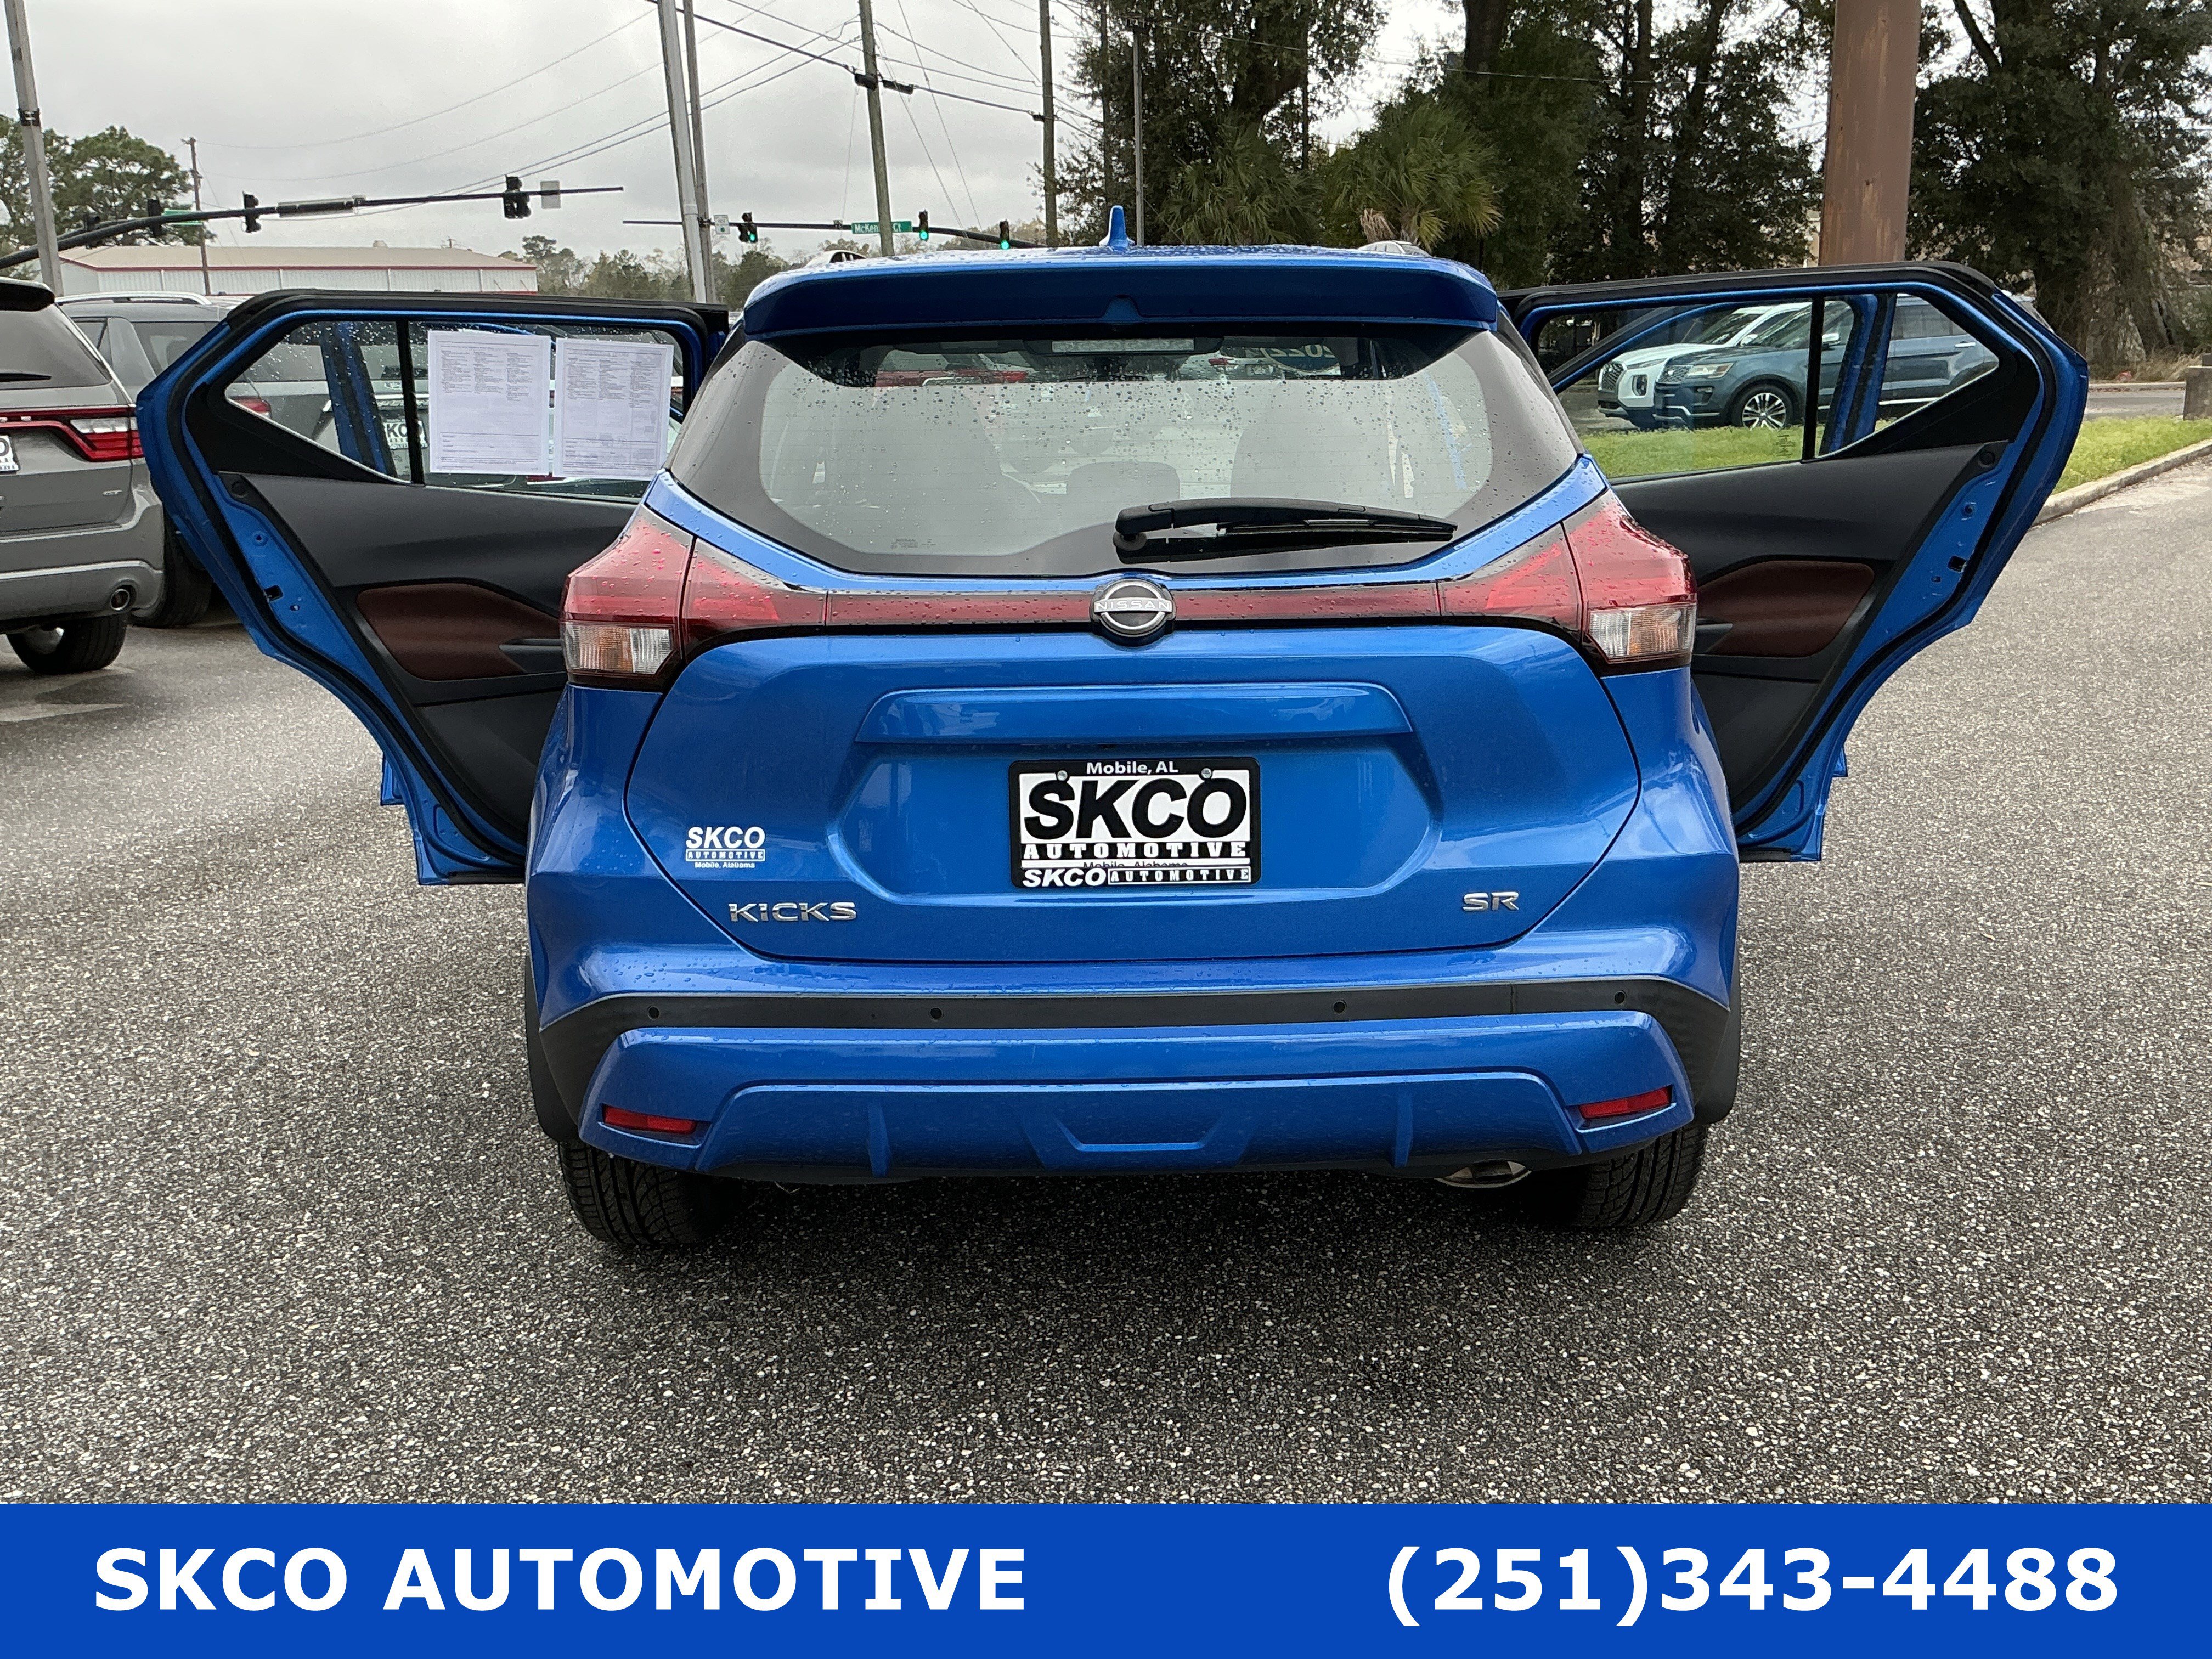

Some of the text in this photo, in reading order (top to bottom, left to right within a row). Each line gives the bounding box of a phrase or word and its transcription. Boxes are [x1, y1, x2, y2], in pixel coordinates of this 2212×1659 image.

[854, 223, 879, 233] McKen
[1096, 601, 1170, 611] NISSAN
[1086, 760, 1178, 775] Mobile, AL
[1024, 778, 1247, 839] SKCO
[686, 826, 765, 849] SKCO
[687, 851, 764, 859] AUTOMOTIVE
[1023, 842, 1246, 859] AUTOMOTIVE
[1022, 868, 1249, 888] SKCO AUTOMOTIVE
[1463, 891, 1519, 911] SR
[729, 902, 857, 922] KICKS
